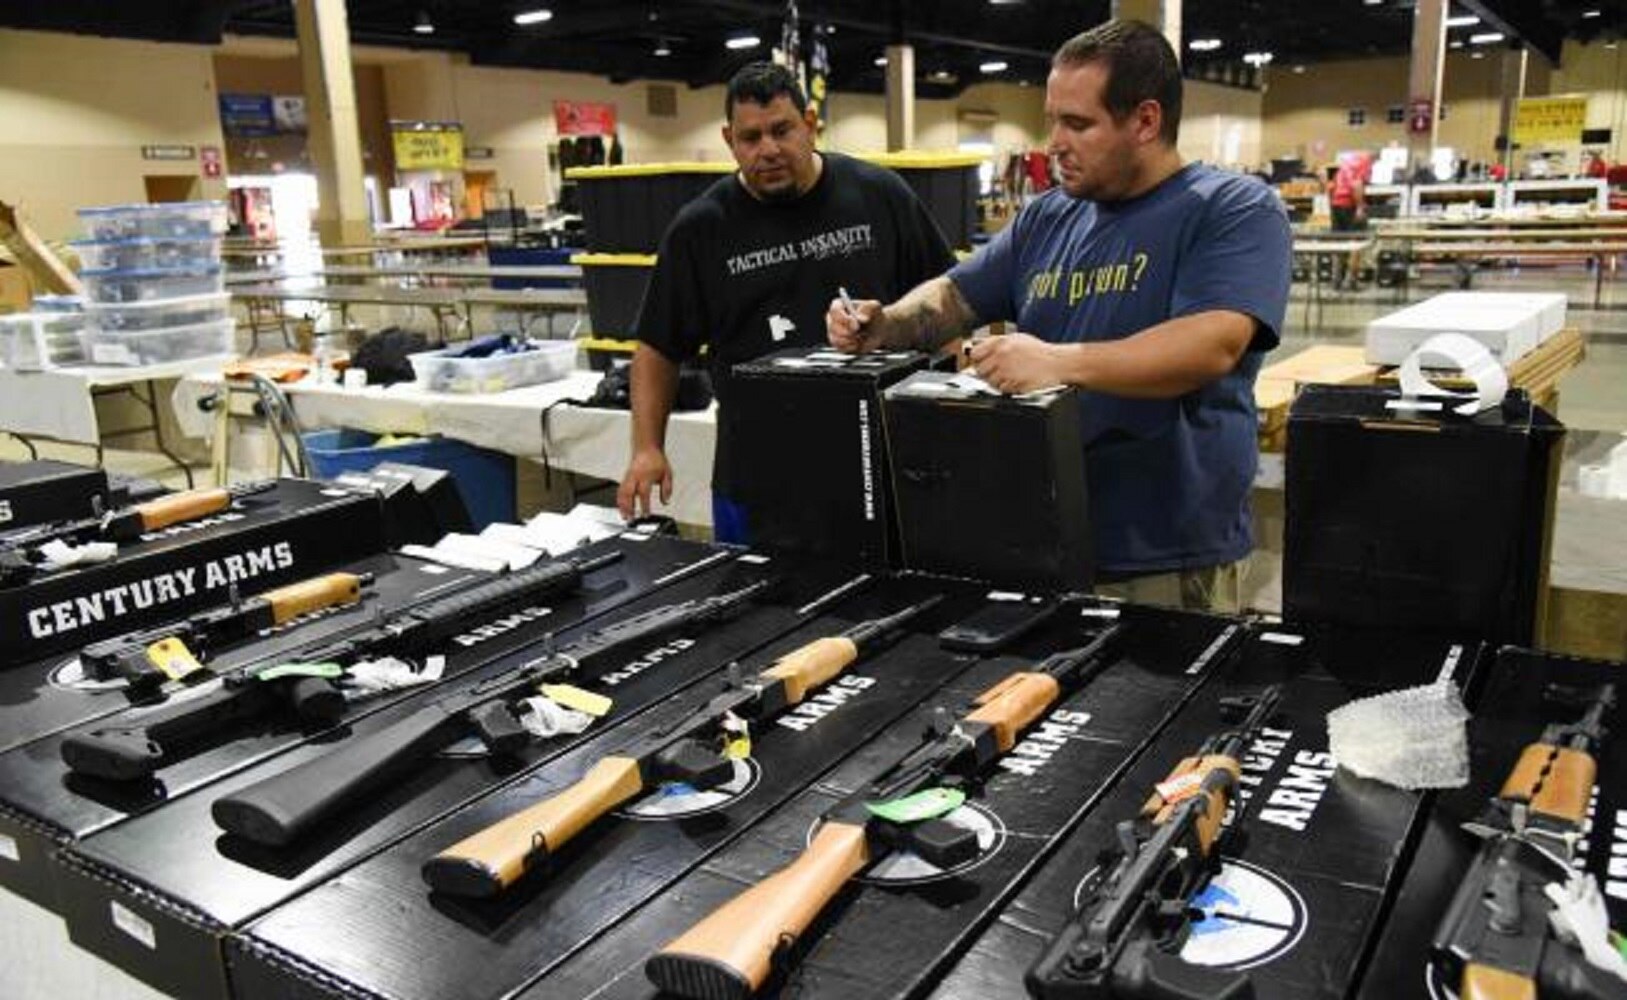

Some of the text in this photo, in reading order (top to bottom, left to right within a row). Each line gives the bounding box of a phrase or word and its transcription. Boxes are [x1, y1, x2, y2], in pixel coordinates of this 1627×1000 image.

[726, 243, 798, 274] TACTICAL
[801, 224, 871, 258] INSANITY
[1069, 252, 1148, 306] pwn?
[27, 566, 196, 639] CENTURY
[205, 541, 294, 590] ARMS
[453, 607, 552, 646] ARMS
[776, 674, 877, 731] ARMS
[999, 709, 1092, 776] ARMS
[1259, 749, 1338, 831] ARMS
